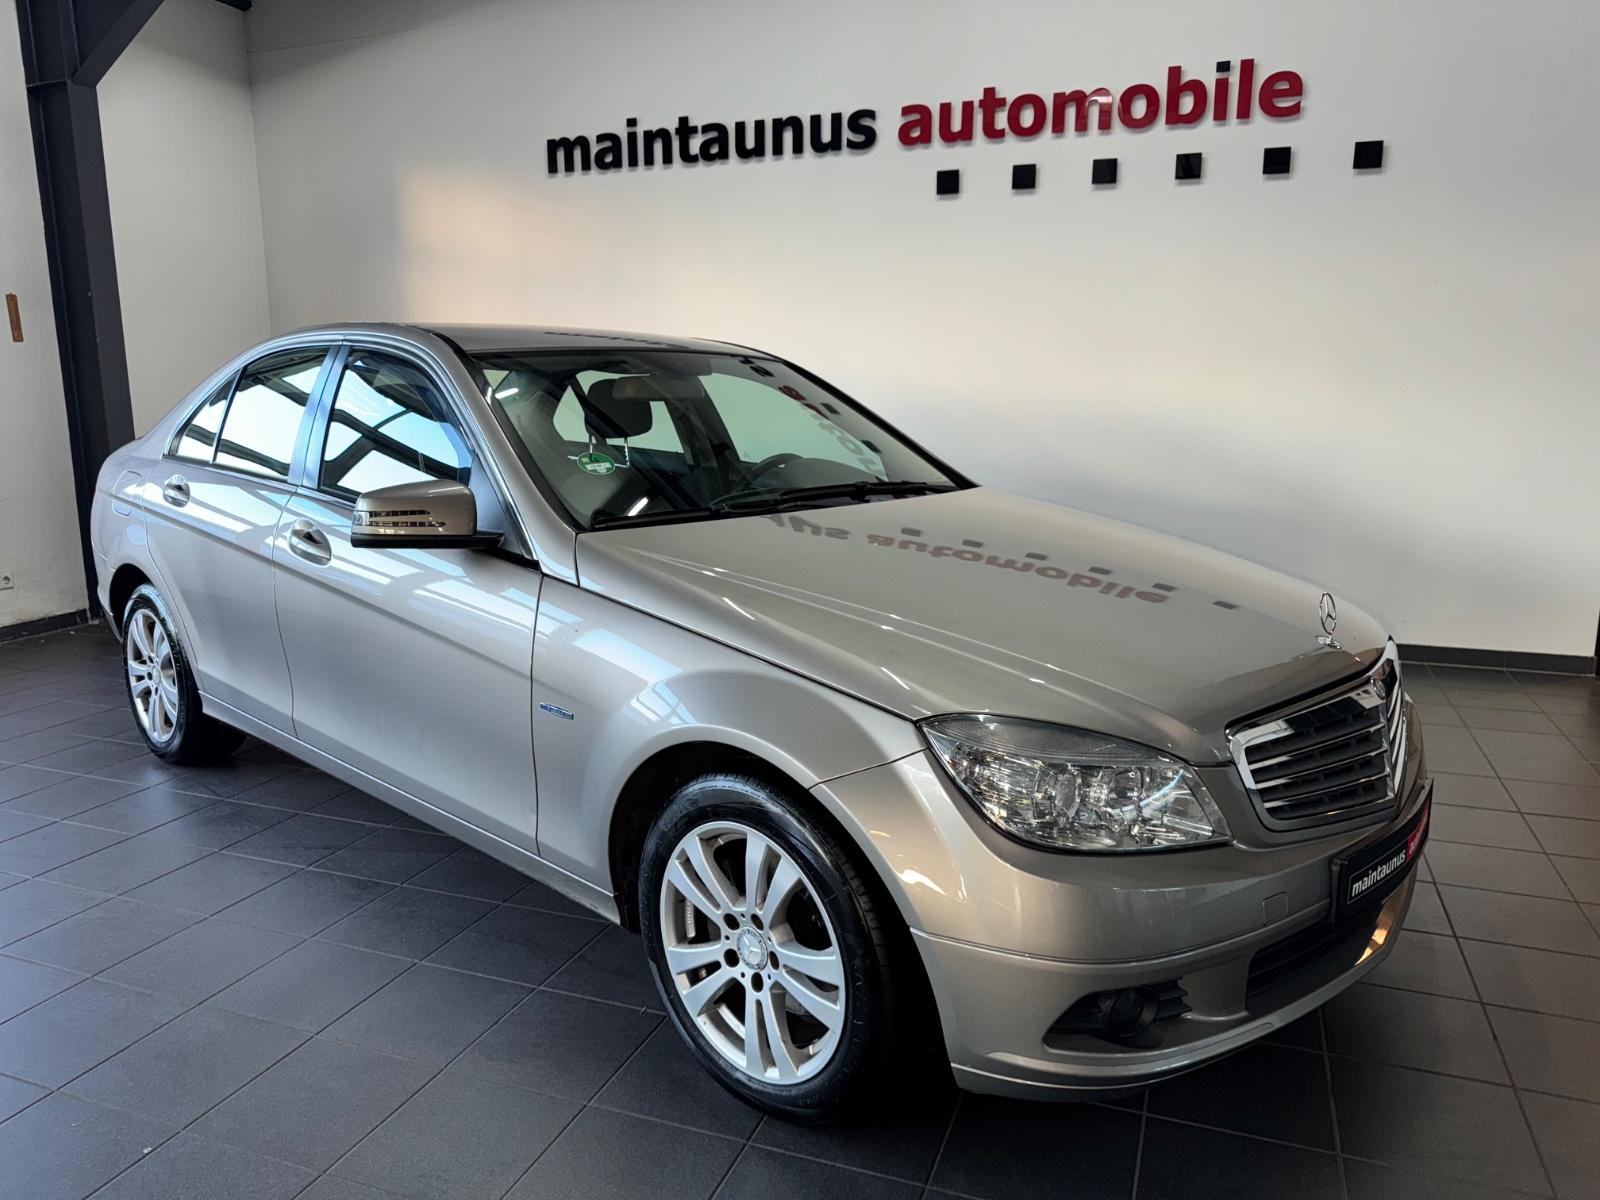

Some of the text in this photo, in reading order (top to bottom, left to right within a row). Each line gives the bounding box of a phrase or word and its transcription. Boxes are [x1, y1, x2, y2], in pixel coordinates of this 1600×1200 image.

[546, 58, 1304, 176] maintaunus automobile
[1351, 848, 1406, 898] maintaunus
